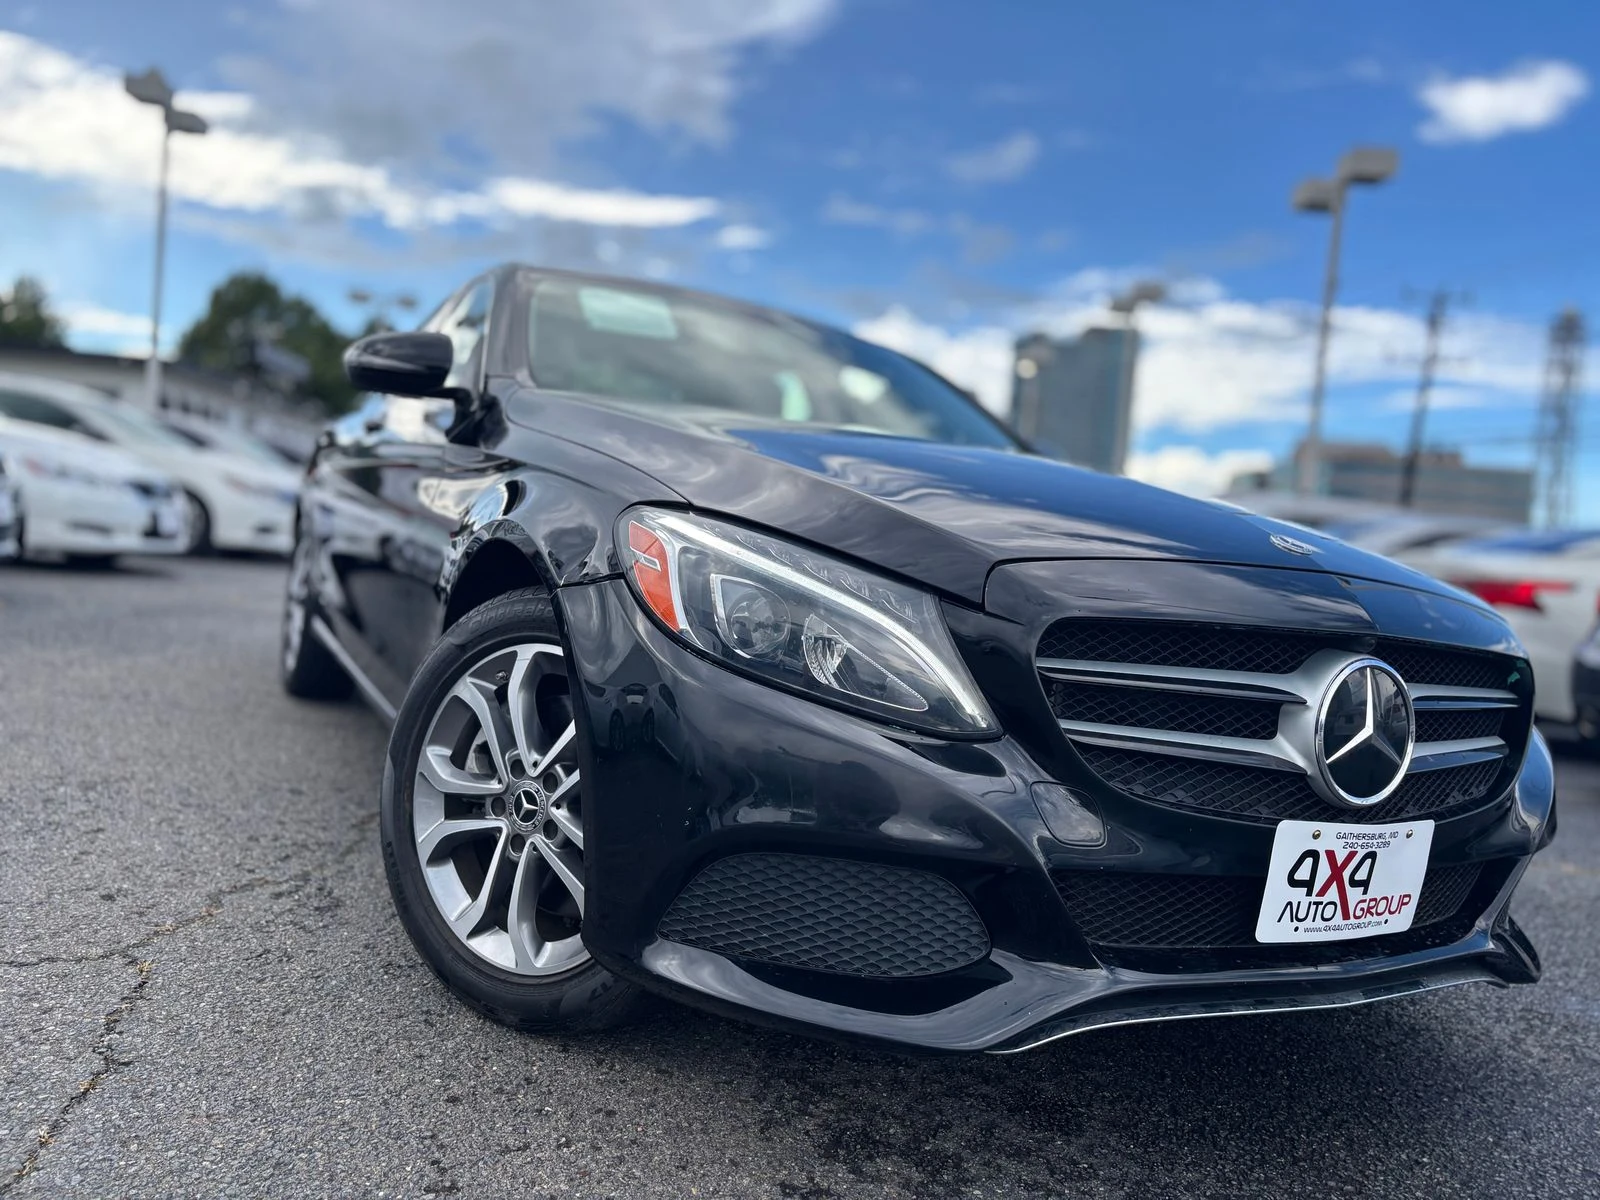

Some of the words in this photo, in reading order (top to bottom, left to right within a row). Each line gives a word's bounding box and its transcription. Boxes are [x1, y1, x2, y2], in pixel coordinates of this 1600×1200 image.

[1336, 831, 1387, 841] GAITHERSBURG,
[1388, 831, 1399, 839] MD
[1342, 841, 1391, 849] 240-654-3289
[1287, 849, 1378, 920] 4X4
[1277, 900, 1338, 923] AUTO
[1352, 894, 1412, 920] GROUP
